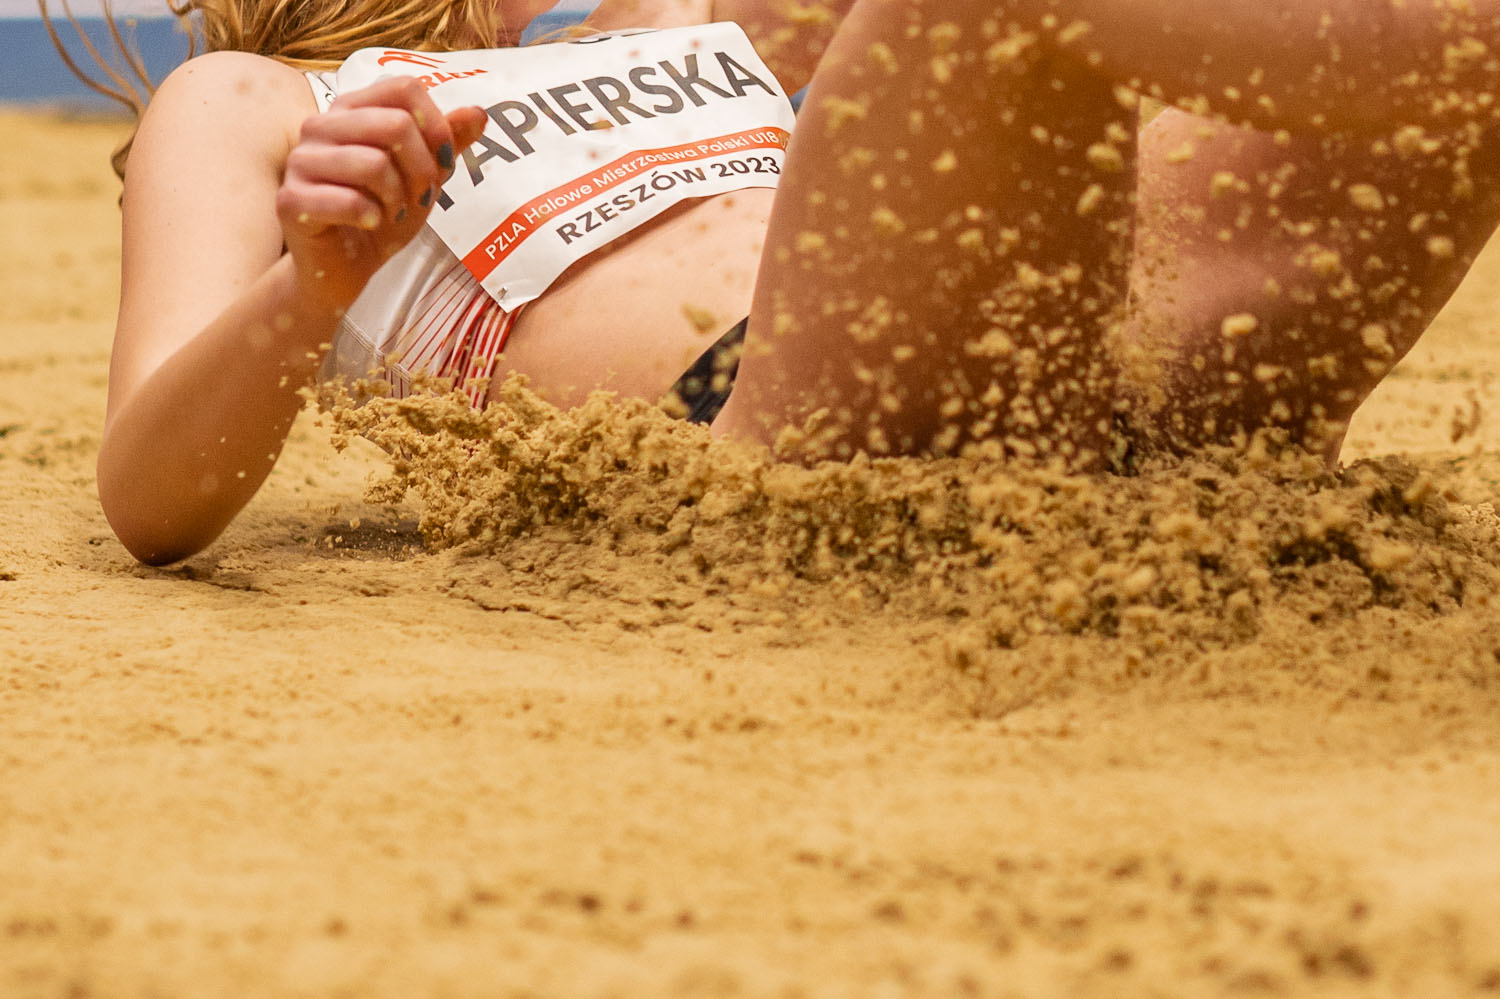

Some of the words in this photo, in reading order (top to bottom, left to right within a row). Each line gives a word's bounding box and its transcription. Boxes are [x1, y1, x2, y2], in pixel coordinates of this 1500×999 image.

[419, 68, 488, 92] RLEN
[485, 221, 527, 260] PZLA
[524, 183, 593, 224] Halowe
[592, 147, 698, 188] Mistrzostwa
[697, 136, 749, 154] Polski
[749, 131, 779, 144] U18
[555, 166, 707, 245] RZESZÓW
[710, 156, 781, 178] 2023
